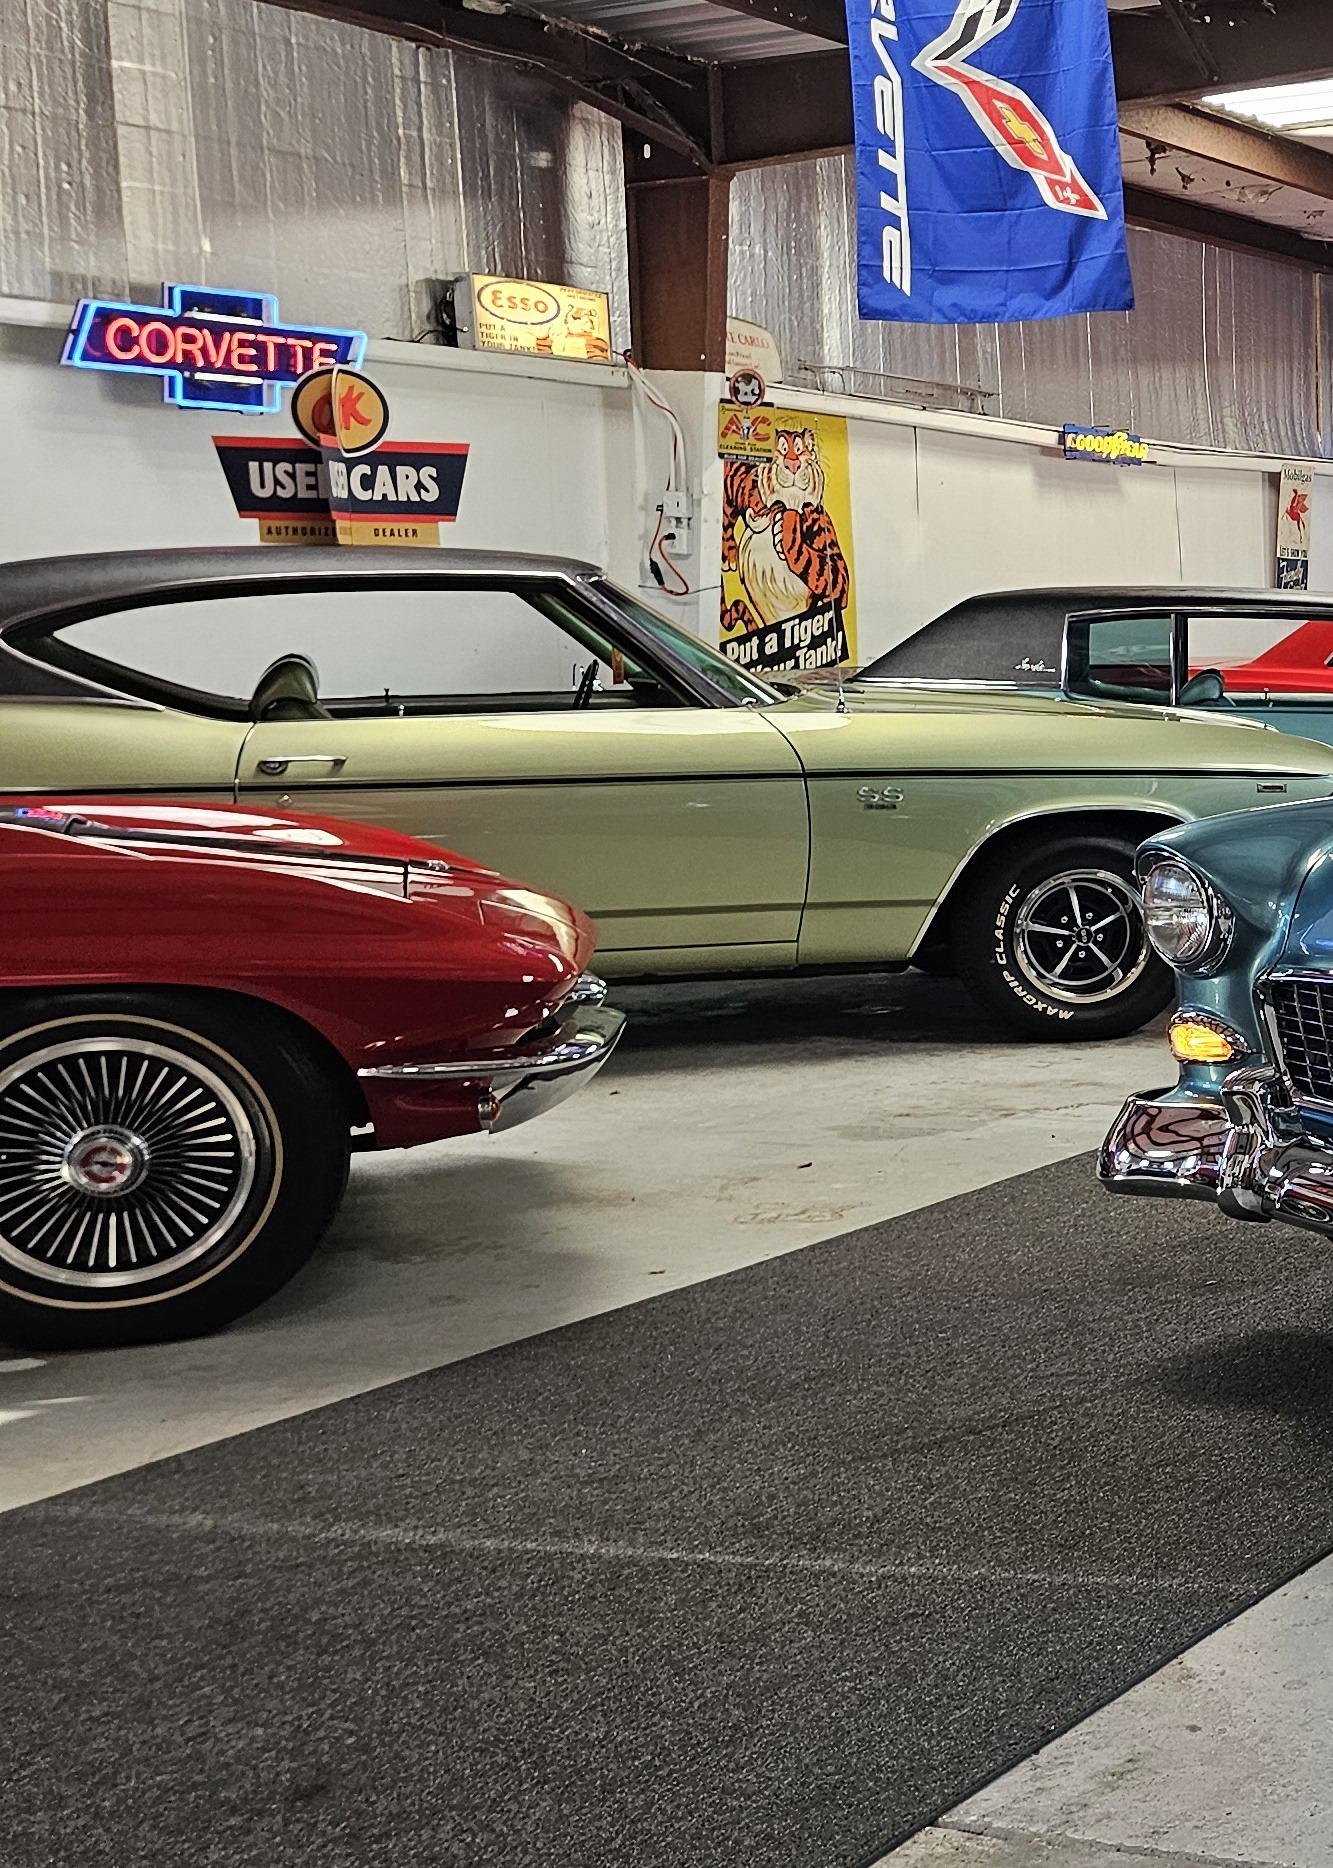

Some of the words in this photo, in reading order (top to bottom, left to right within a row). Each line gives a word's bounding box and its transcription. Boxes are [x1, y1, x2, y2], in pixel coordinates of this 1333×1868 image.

[104, 317, 339, 374] CORVETTE
[248, 461, 329, 498] USE
[350, 465, 440, 502] CARS
[1284, 469, 1312, 485] Mobilgas
[373, 528, 418, 538] DEALER
[726, 636, 759, 665] Put
[764, 632, 778, 655] a
[782, 610, 833, 648] Tiger
[796, 631, 843, 669] Tank!
[858, 786, 904, 802] SS
[994, 883, 1021, 965] CLASSIC
[1003, 970, 1074, 1020] MAXGRIP
